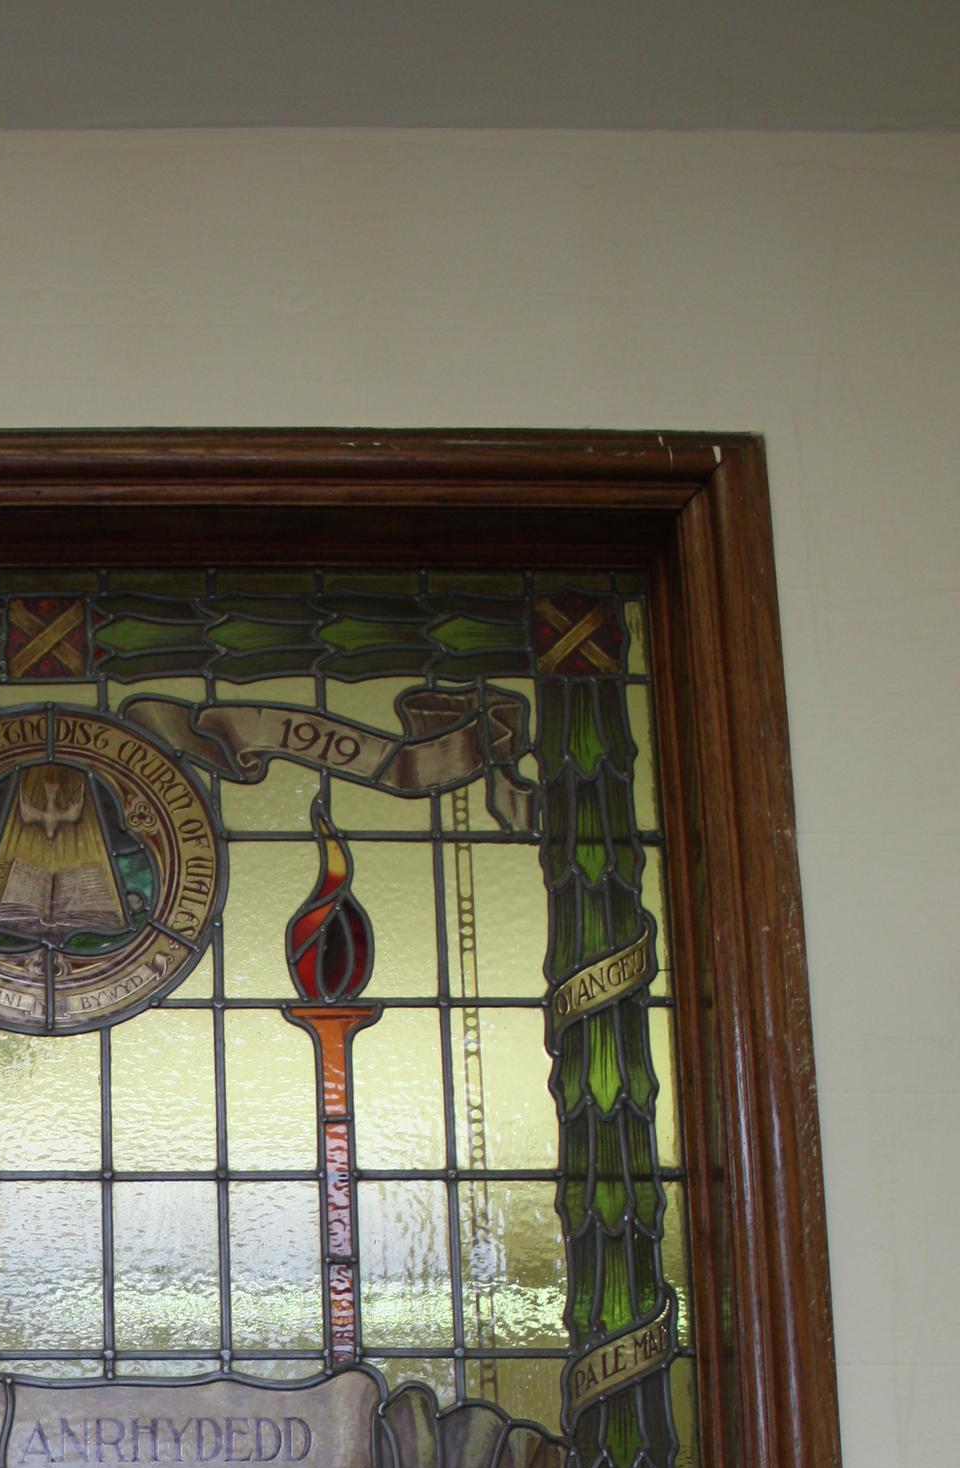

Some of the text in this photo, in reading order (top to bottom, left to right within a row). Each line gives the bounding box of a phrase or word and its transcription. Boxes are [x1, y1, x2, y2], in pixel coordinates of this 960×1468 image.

[279, 718, 361, 766] 1919
[117, 740, 196, 814] CHURCH
[178, 818, 210, 850] OF
[170, 855, 214, 938] WALES
[577, 946, 647, 1004] ANGEU
[18, 1416, 314, 1464] ANRHYDEDD
